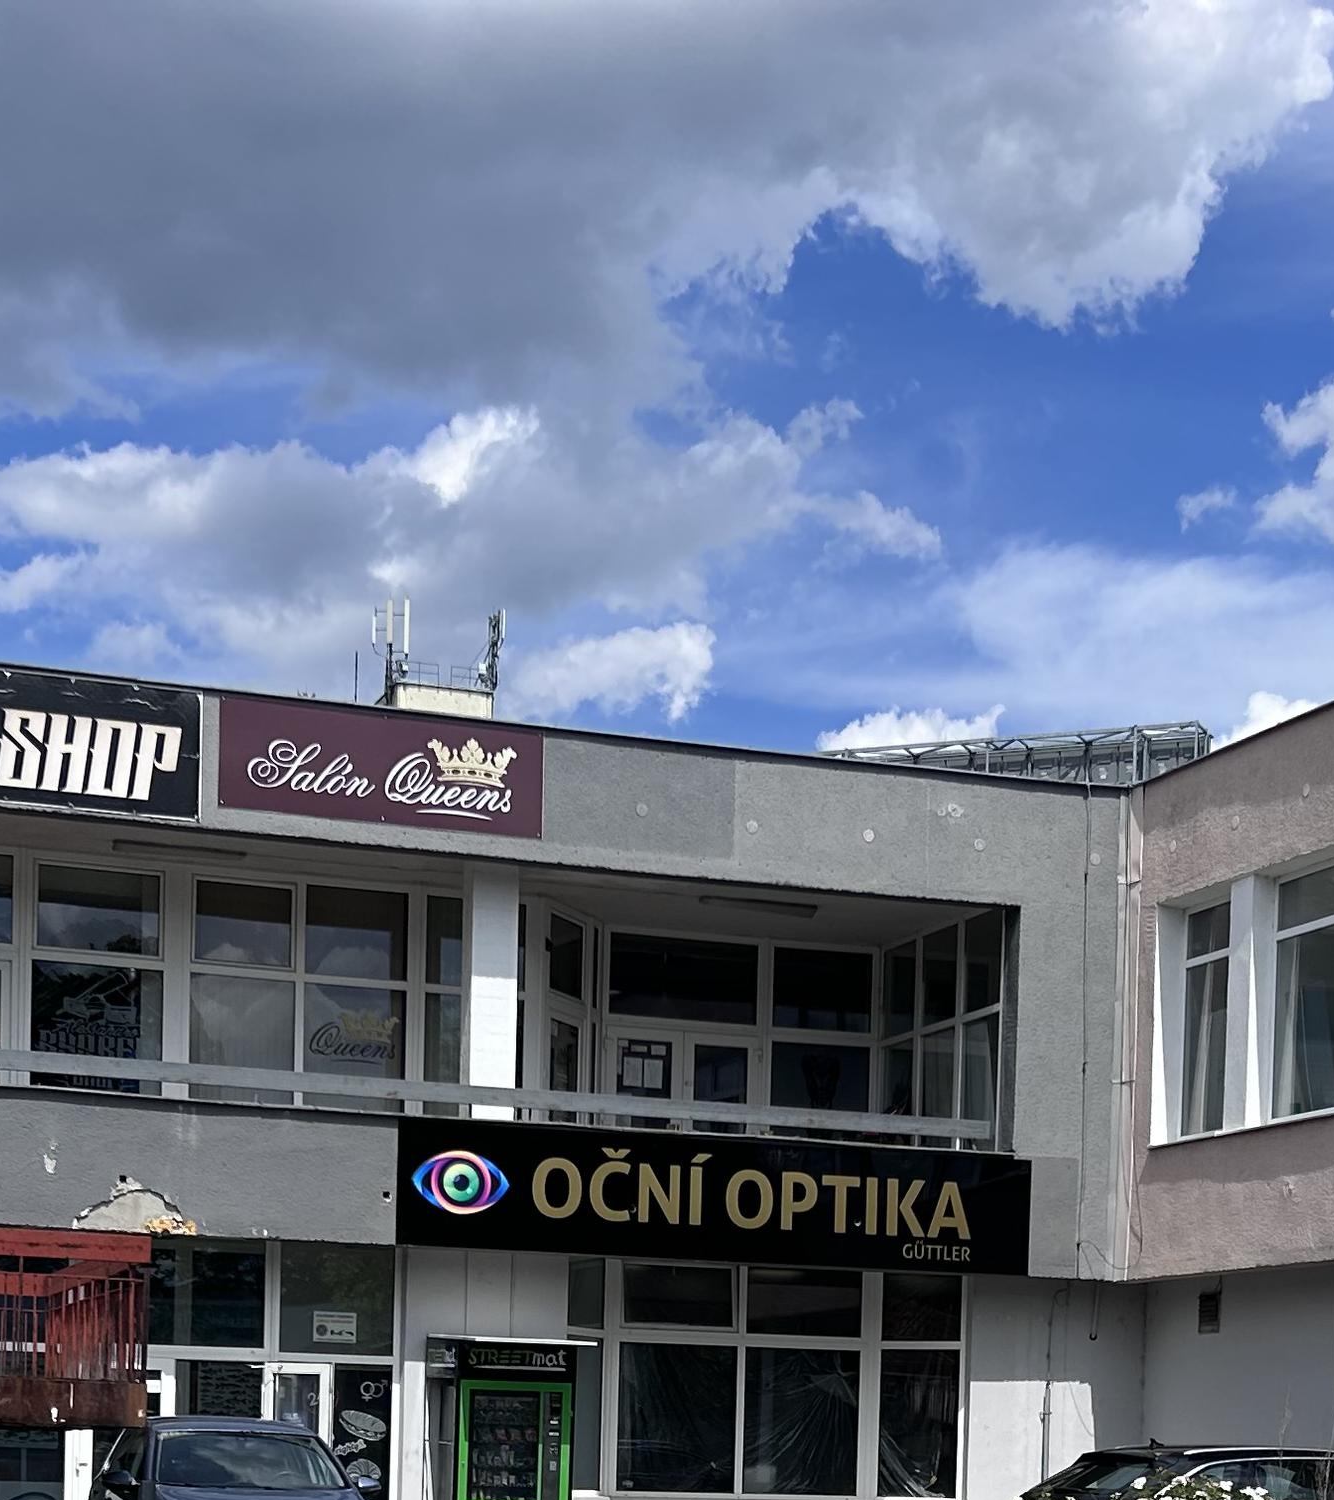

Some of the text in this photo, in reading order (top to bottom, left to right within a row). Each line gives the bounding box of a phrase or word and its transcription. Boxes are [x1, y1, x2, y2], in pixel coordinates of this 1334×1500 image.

[247, 738, 512, 813] Salón Queens
[309, 1020, 396, 1060] Queens
[532, 1147, 972, 1240] OČNÍ OPTIKA
[902, 1240, 971, 1262] GÜTTLER
